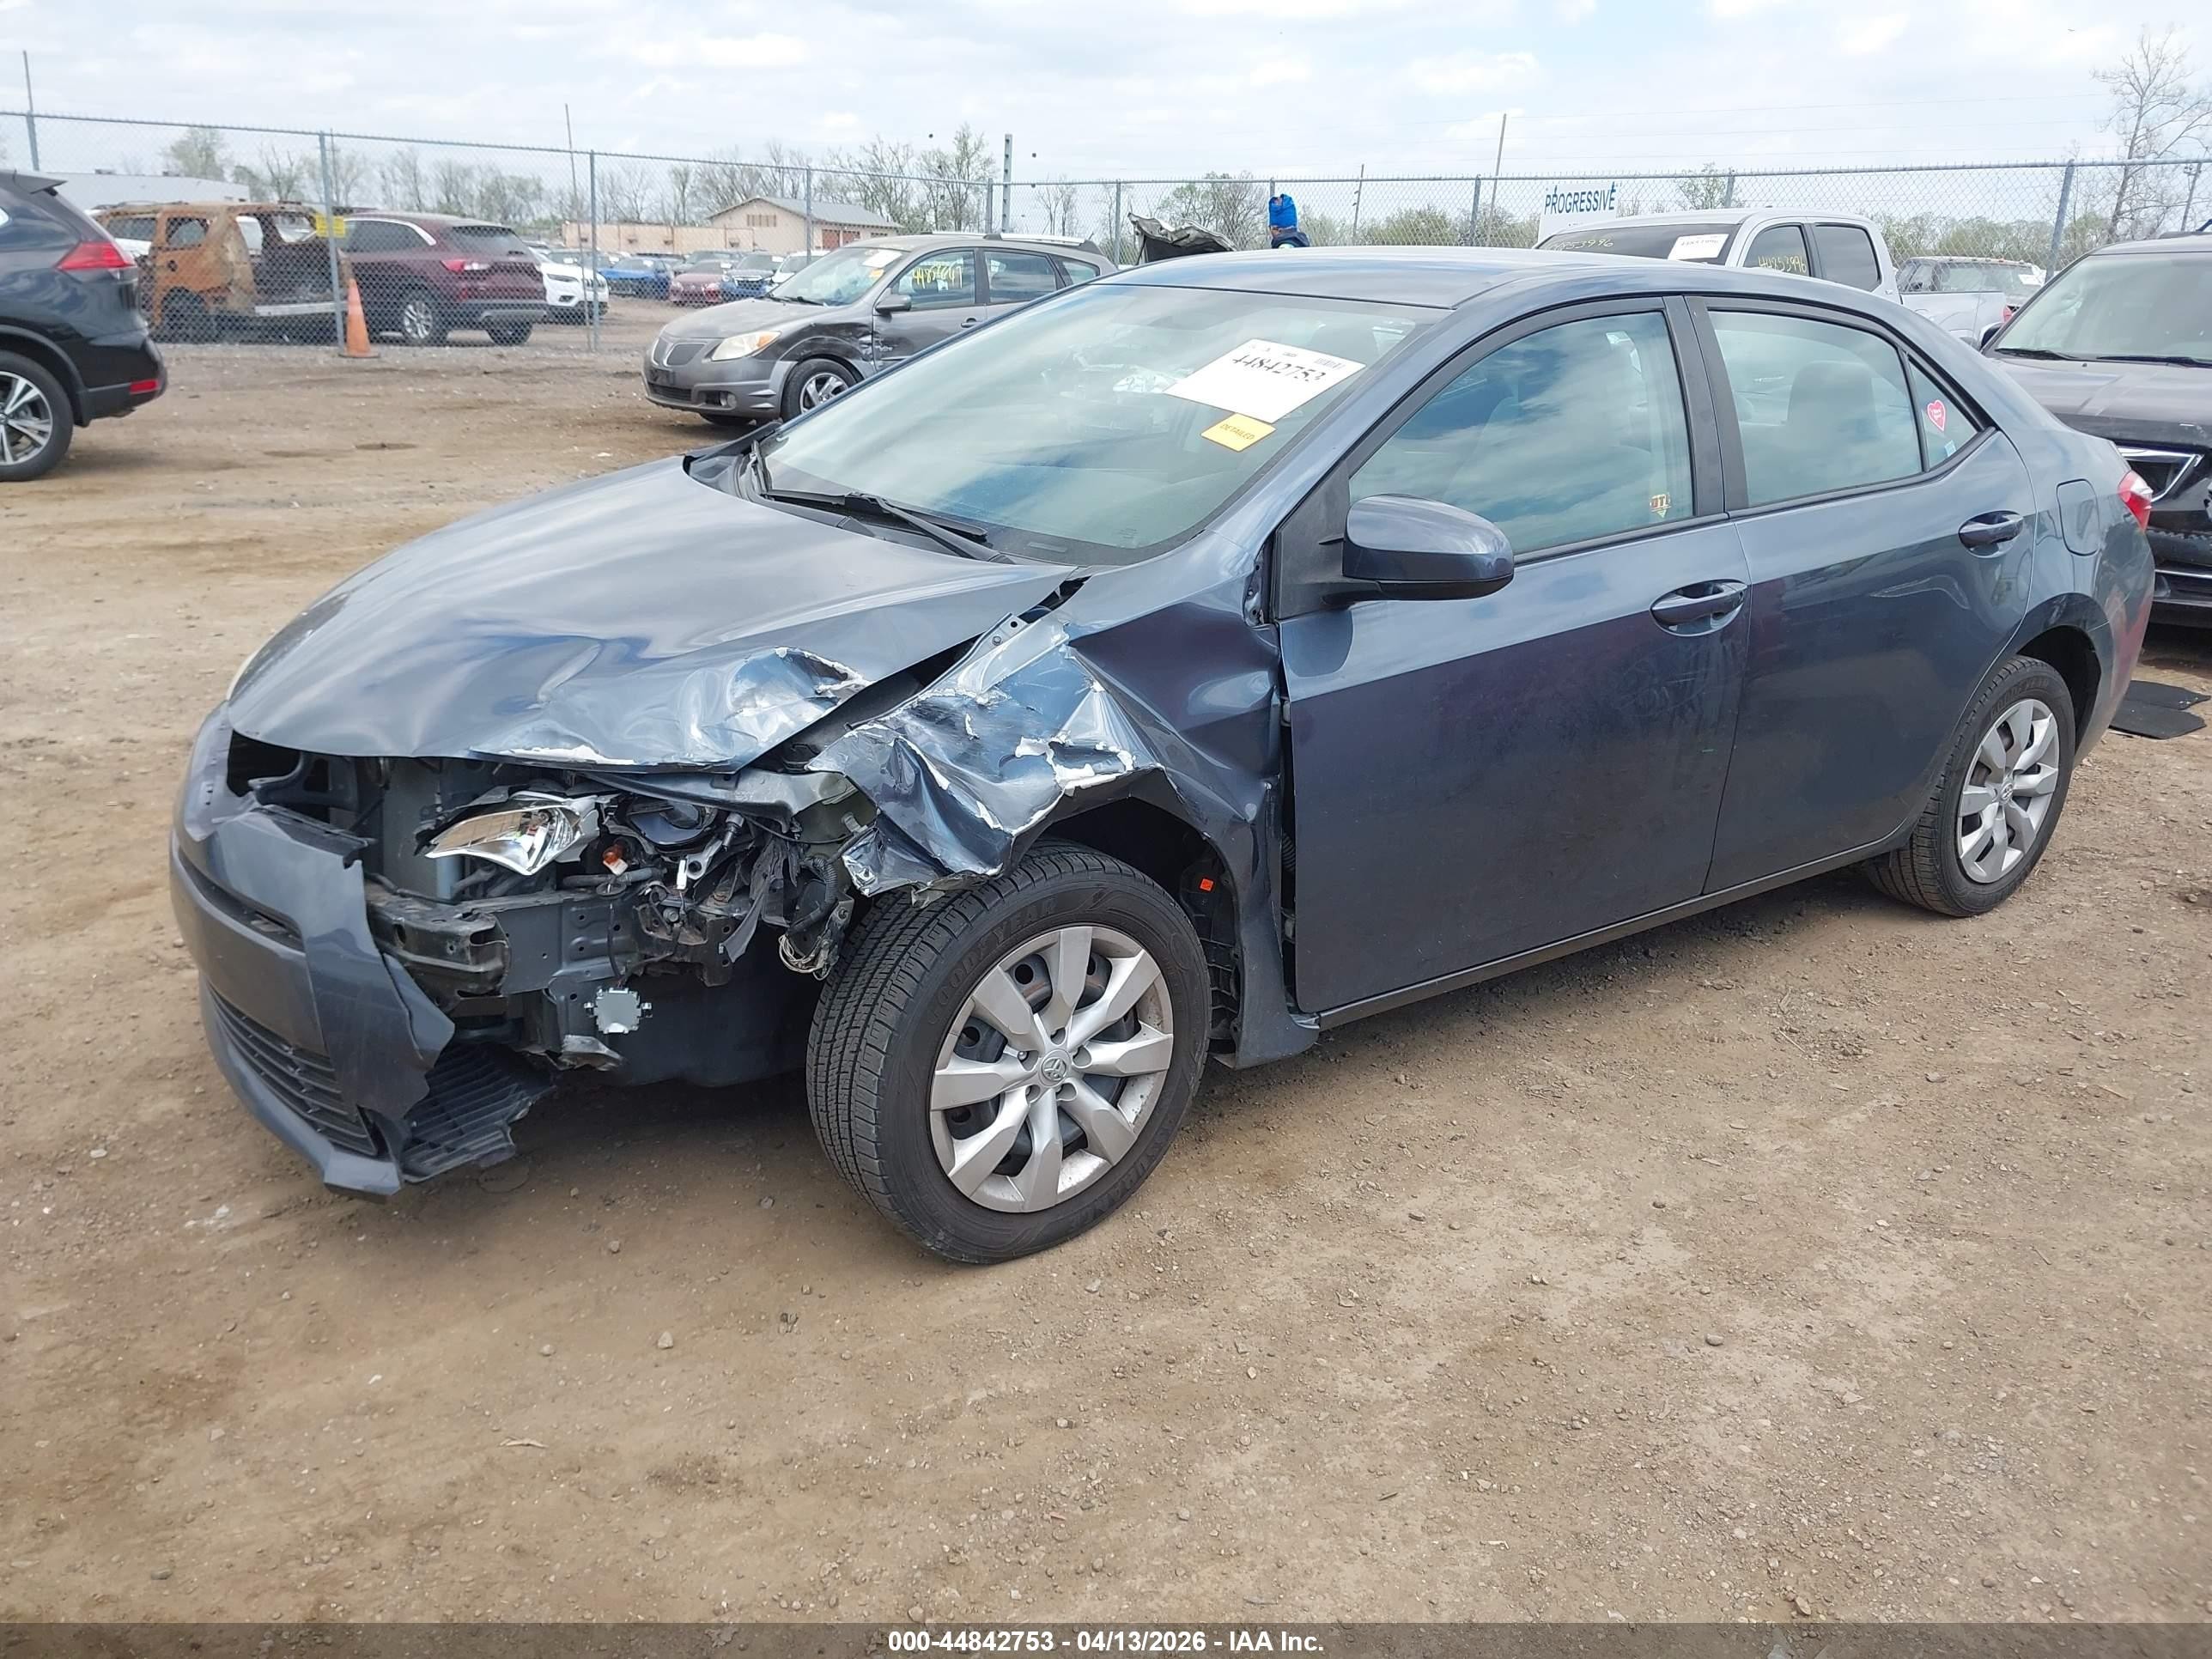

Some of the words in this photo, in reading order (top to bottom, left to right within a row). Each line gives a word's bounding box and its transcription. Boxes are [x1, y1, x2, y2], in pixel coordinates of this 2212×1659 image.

[1545, 188, 1614, 215] PROGRESSIVE
[1232, 355, 1326, 381] 44842753
[1219, 423, 1255, 440] DETAILED
